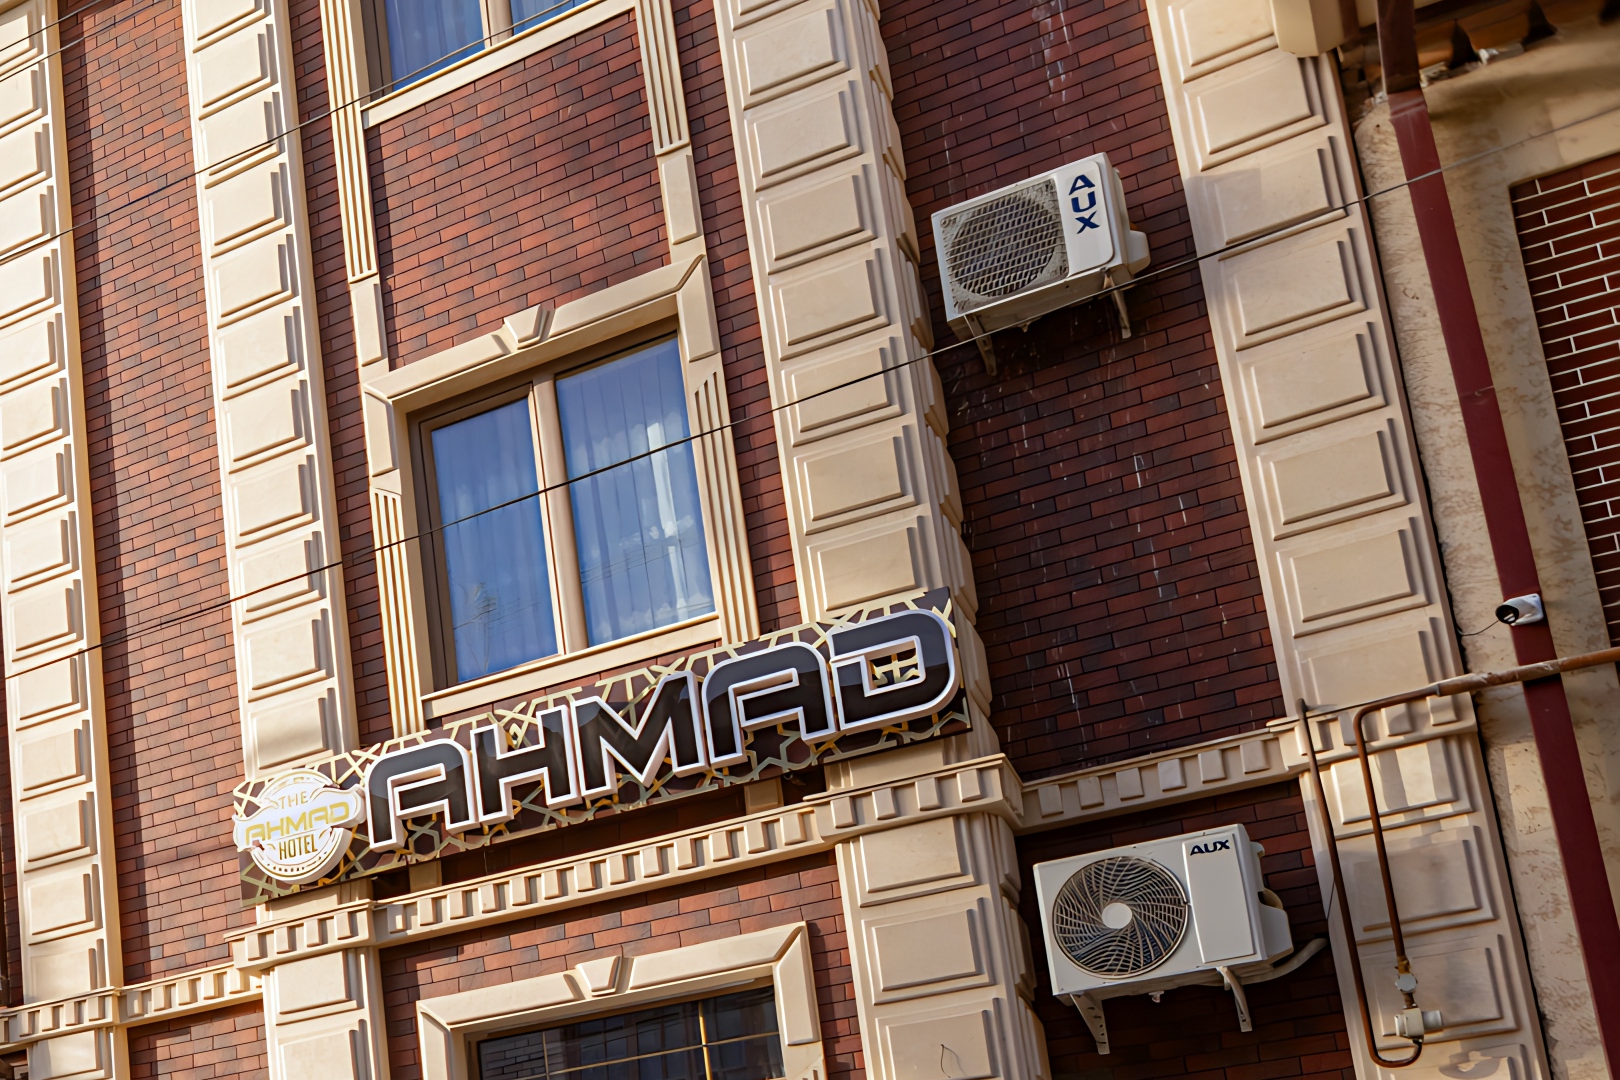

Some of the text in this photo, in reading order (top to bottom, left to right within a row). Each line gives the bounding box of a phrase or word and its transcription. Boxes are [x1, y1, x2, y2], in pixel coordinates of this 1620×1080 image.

[1068, 174, 1100, 235] AUX
[367, 608, 960, 852] AHMAD
[278, 790, 309, 809] THE
[245, 801, 350, 846] AHMAD
[278, 833, 318, 860] HOTEL
[1189, 839, 1231, 856] AUX
